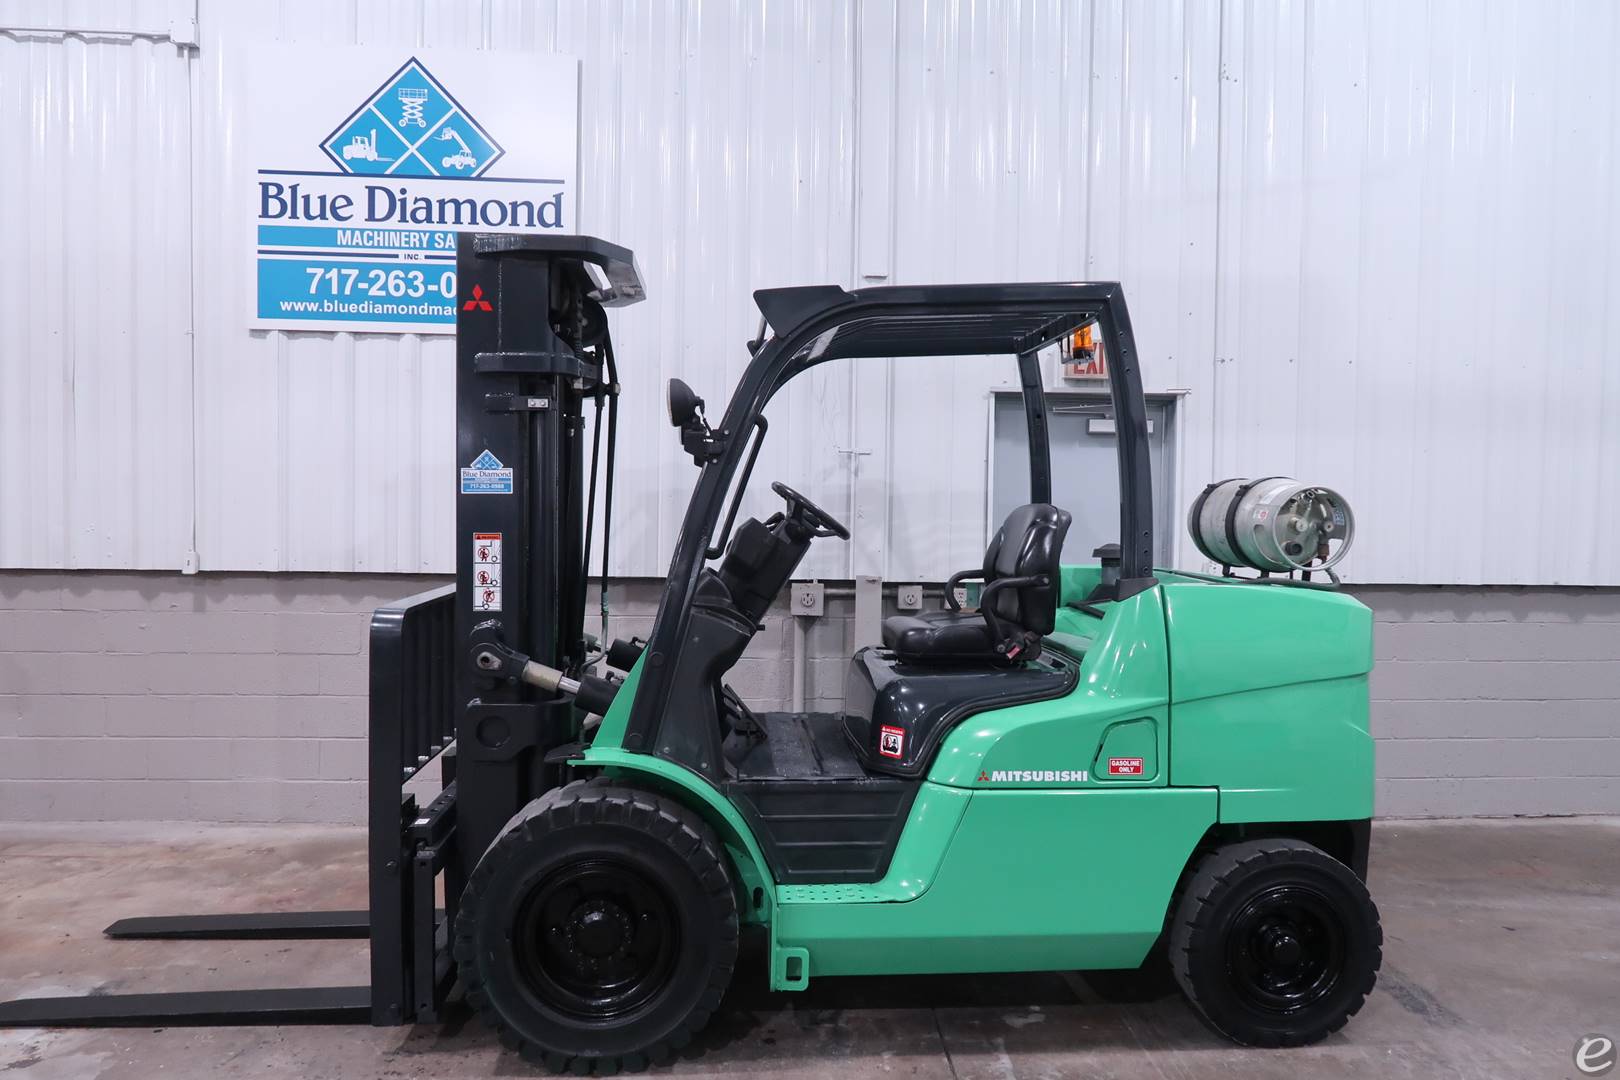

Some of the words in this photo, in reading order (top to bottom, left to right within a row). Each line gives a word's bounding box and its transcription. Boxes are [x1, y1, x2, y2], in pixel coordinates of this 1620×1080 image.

[257, 181, 354, 221] Blue
[364, 185, 564, 229] Diamond
[336, 229, 430, 249] MACHINERY
[434, 232, 456, 249] SA
[305, 267, 457, 299] 717-263-0
[479, 470, 511, 478] Diamond
[991, 770, 1088, 782] MITSUBISHI
